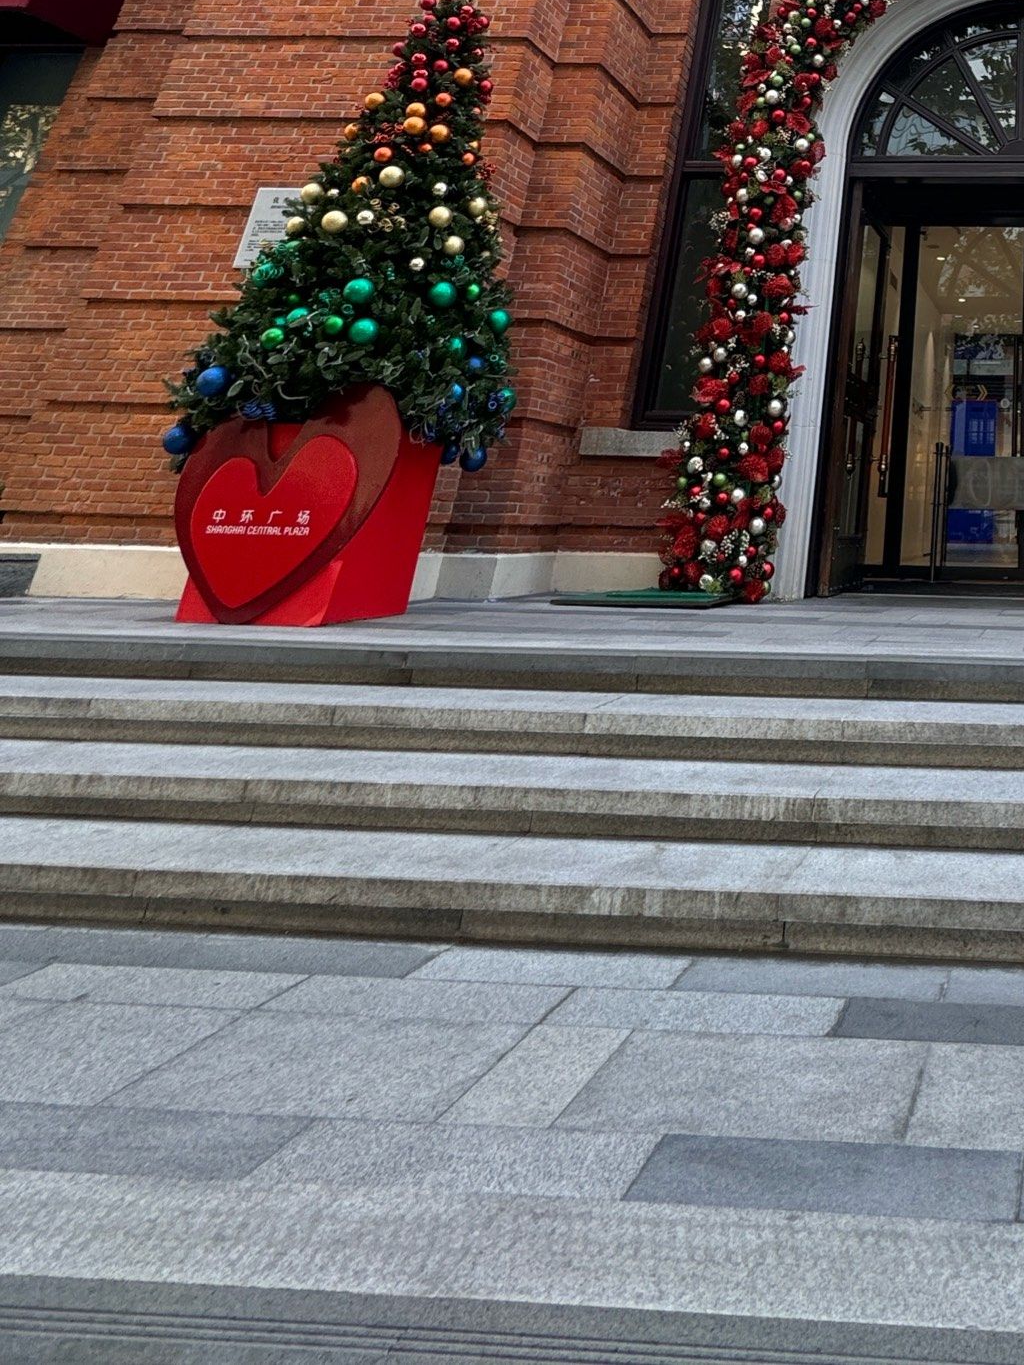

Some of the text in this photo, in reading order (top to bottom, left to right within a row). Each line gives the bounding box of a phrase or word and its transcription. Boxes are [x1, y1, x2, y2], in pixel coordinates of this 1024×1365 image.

[212, 509, 311, 525] 中环广场
[205, 524, 310, 536] SHANGHAI CENTRAL PLAZA
